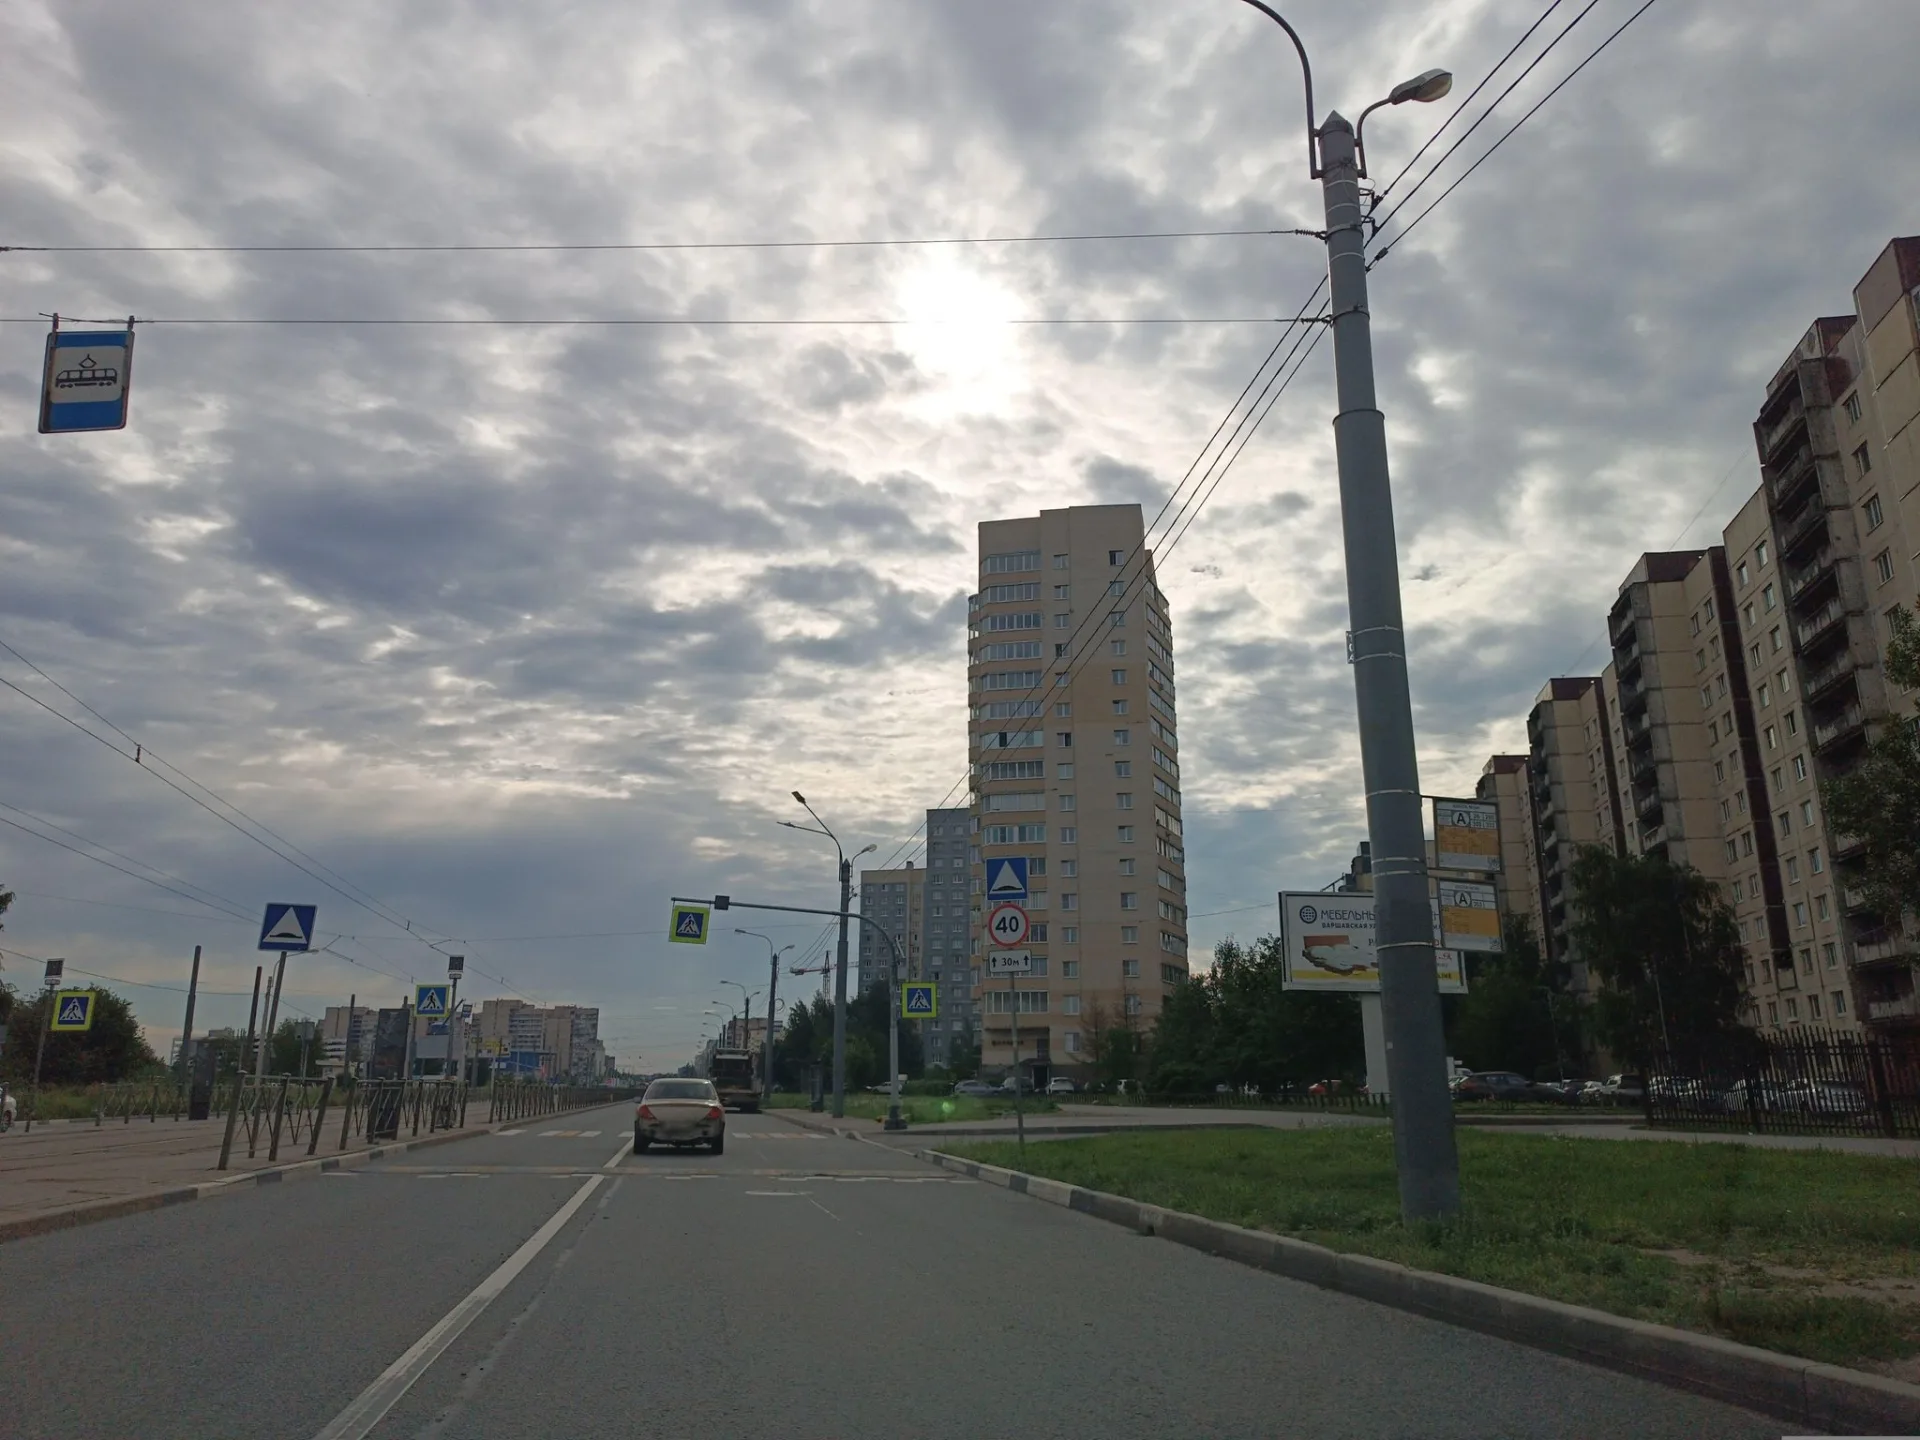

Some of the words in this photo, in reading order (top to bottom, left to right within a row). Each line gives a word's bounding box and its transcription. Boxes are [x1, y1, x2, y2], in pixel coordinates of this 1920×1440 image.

[1457, 813, 1466, 825] А
[1459, 893, 1468, 904] А
[1320, 909, 1376, 921] МЕБЕЛЬНЫ
[995, 916, 1019, 933] 40
[1001, 957, 1020, 967] 30м
